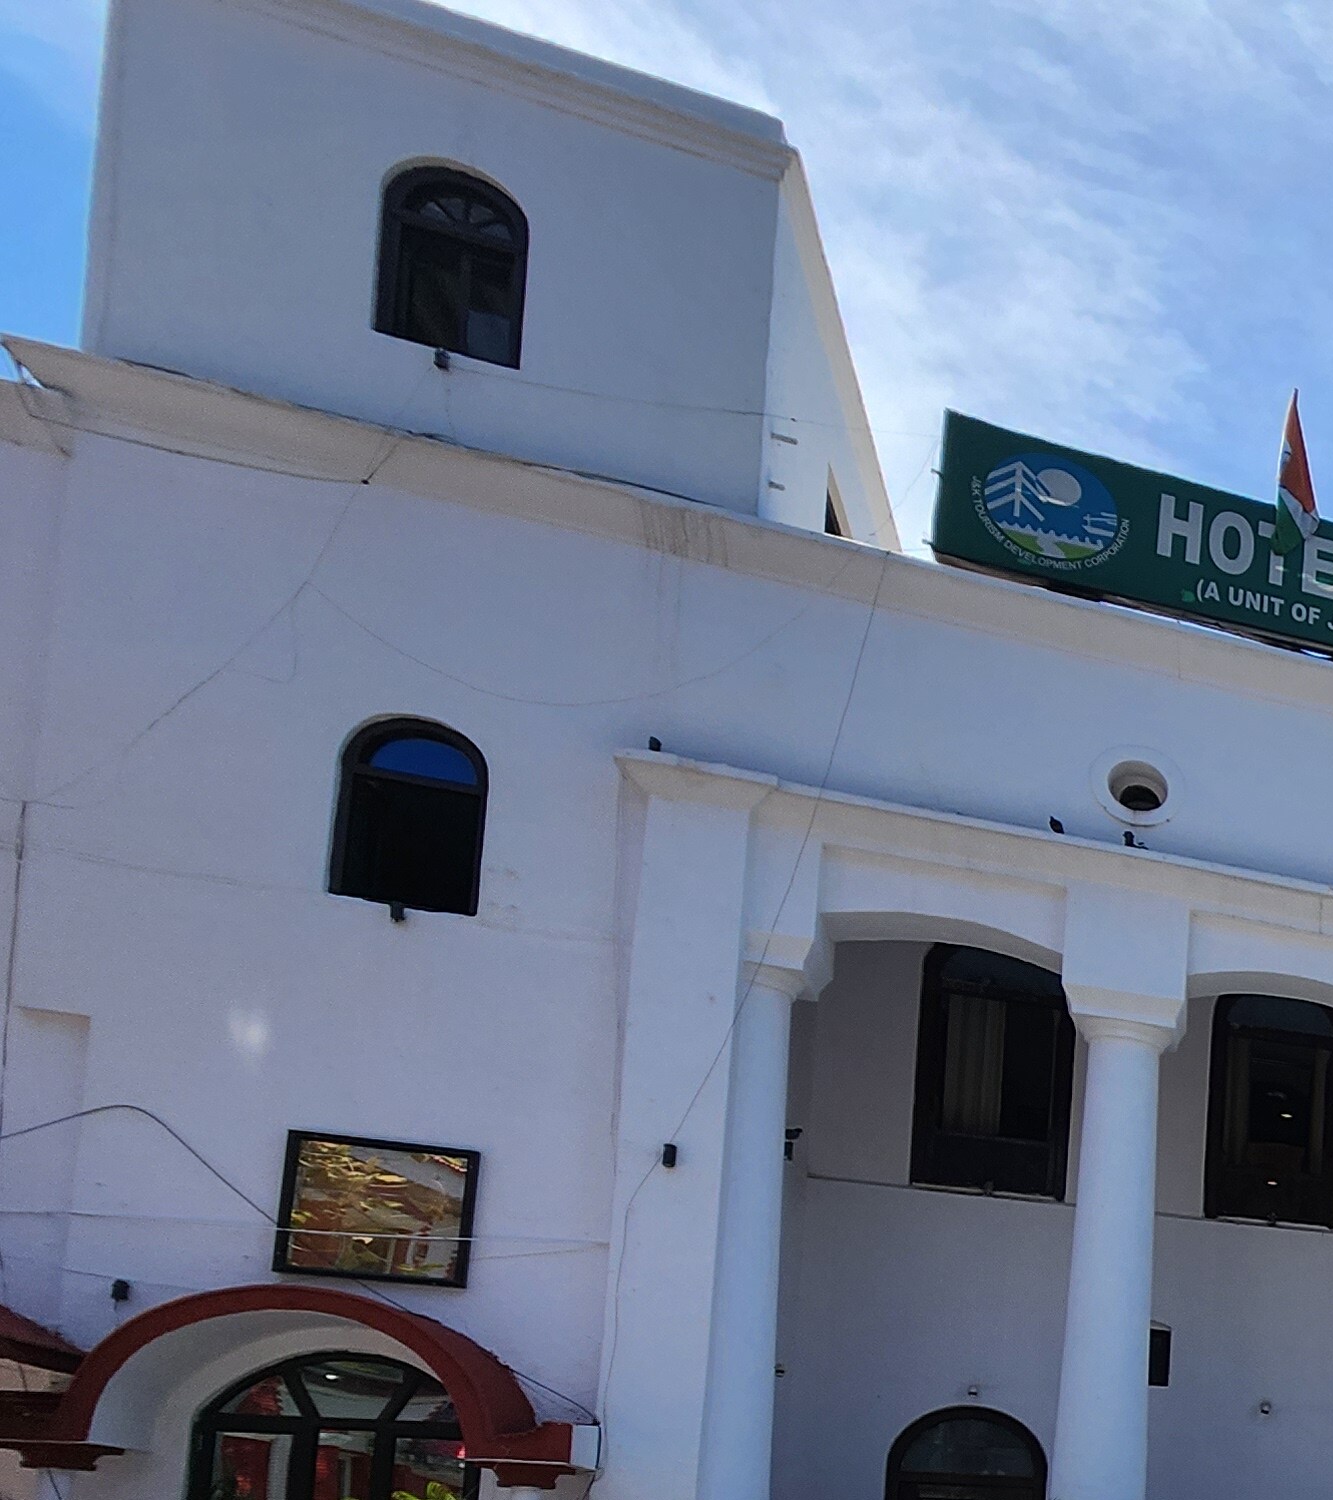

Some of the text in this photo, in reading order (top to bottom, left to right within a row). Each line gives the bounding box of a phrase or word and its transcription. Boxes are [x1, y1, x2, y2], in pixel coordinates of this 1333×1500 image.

[971, 475, 1131, 571] J&K TOURISM DEVELOPMENT CORPORATION
[1196, 578, 1221, 602] (A
[1228, 585, 1284, 617] UNIT
[1291, 603, 1321, 625] OF
